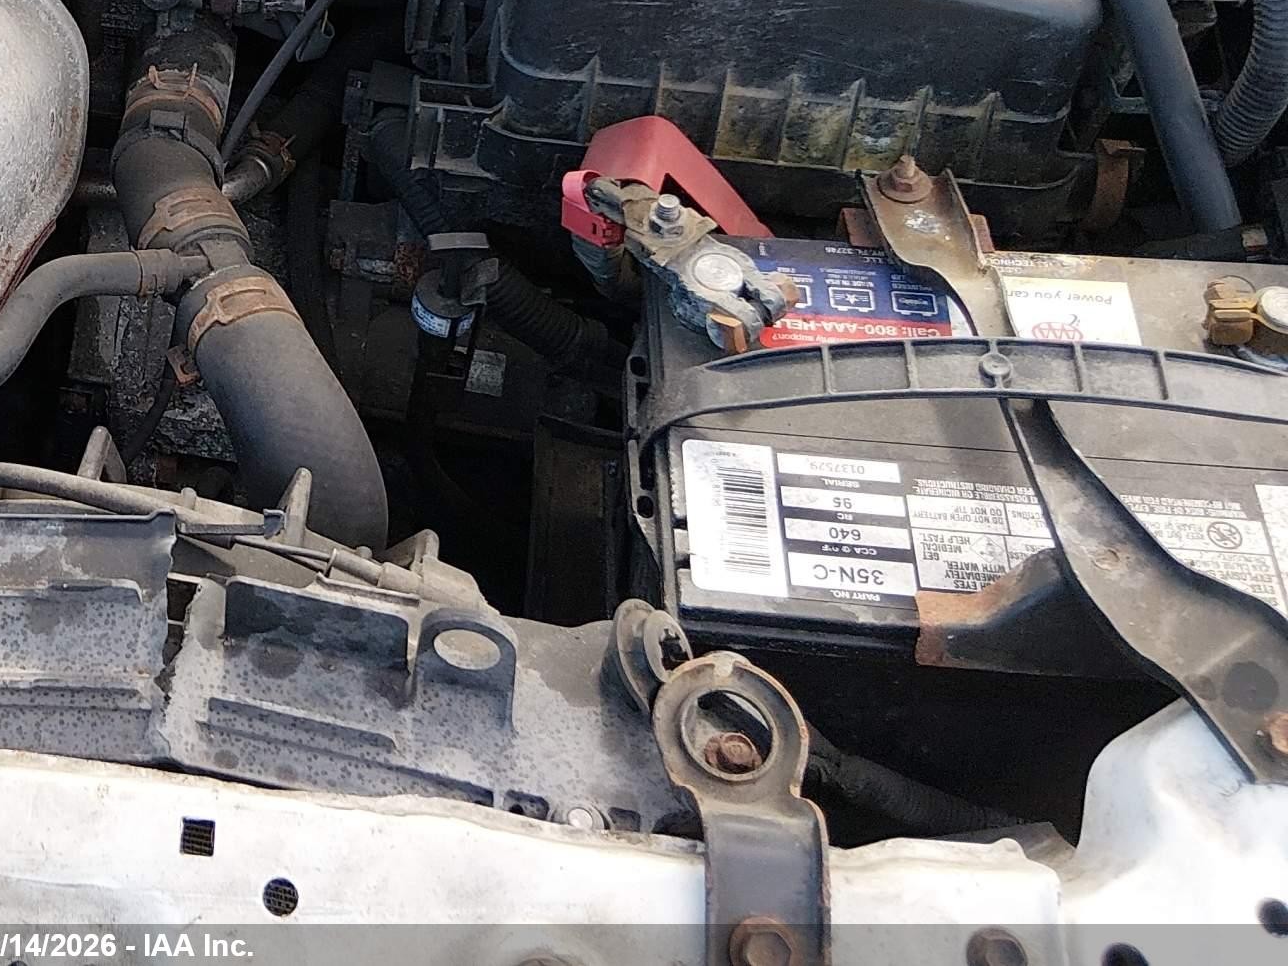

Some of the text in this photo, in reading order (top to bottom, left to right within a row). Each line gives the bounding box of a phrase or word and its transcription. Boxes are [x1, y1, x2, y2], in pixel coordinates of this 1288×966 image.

[1035, 290, 1061, 301] you
[1068, 295, 1112, 305] Power
[902, 326, 940, 337] Call:
[772, 333, 813, 342] support?
[821, 478, 860, 488] SERIAL
[1017, 486, 1033, 495] PER
[832, 497, 852, 509] 95
[971, 507, 988, 515] NOT
[990, 508, 1002, 516] DO
[836, 513, 853, 521] RC
[913, 510, 1004, 525] DO NOT OPEN BATTERY
[828, 527, 861, 542] 640
[920, 533, 970, 544] HELP FAST.
[854, 546, 877, 555] CCA
[920, 542, 963, 553] MEDICAL
[922, 550, 939, 561] GET
[943, 560, 1006, 574] WITH WATER.
[813, 564, 885, 586] 35N-C
[944, 569, 1000, 582] MEDIATELY
[953, 579, 977, 590] EYES
[830, 589, 880, 602] PART NO.
